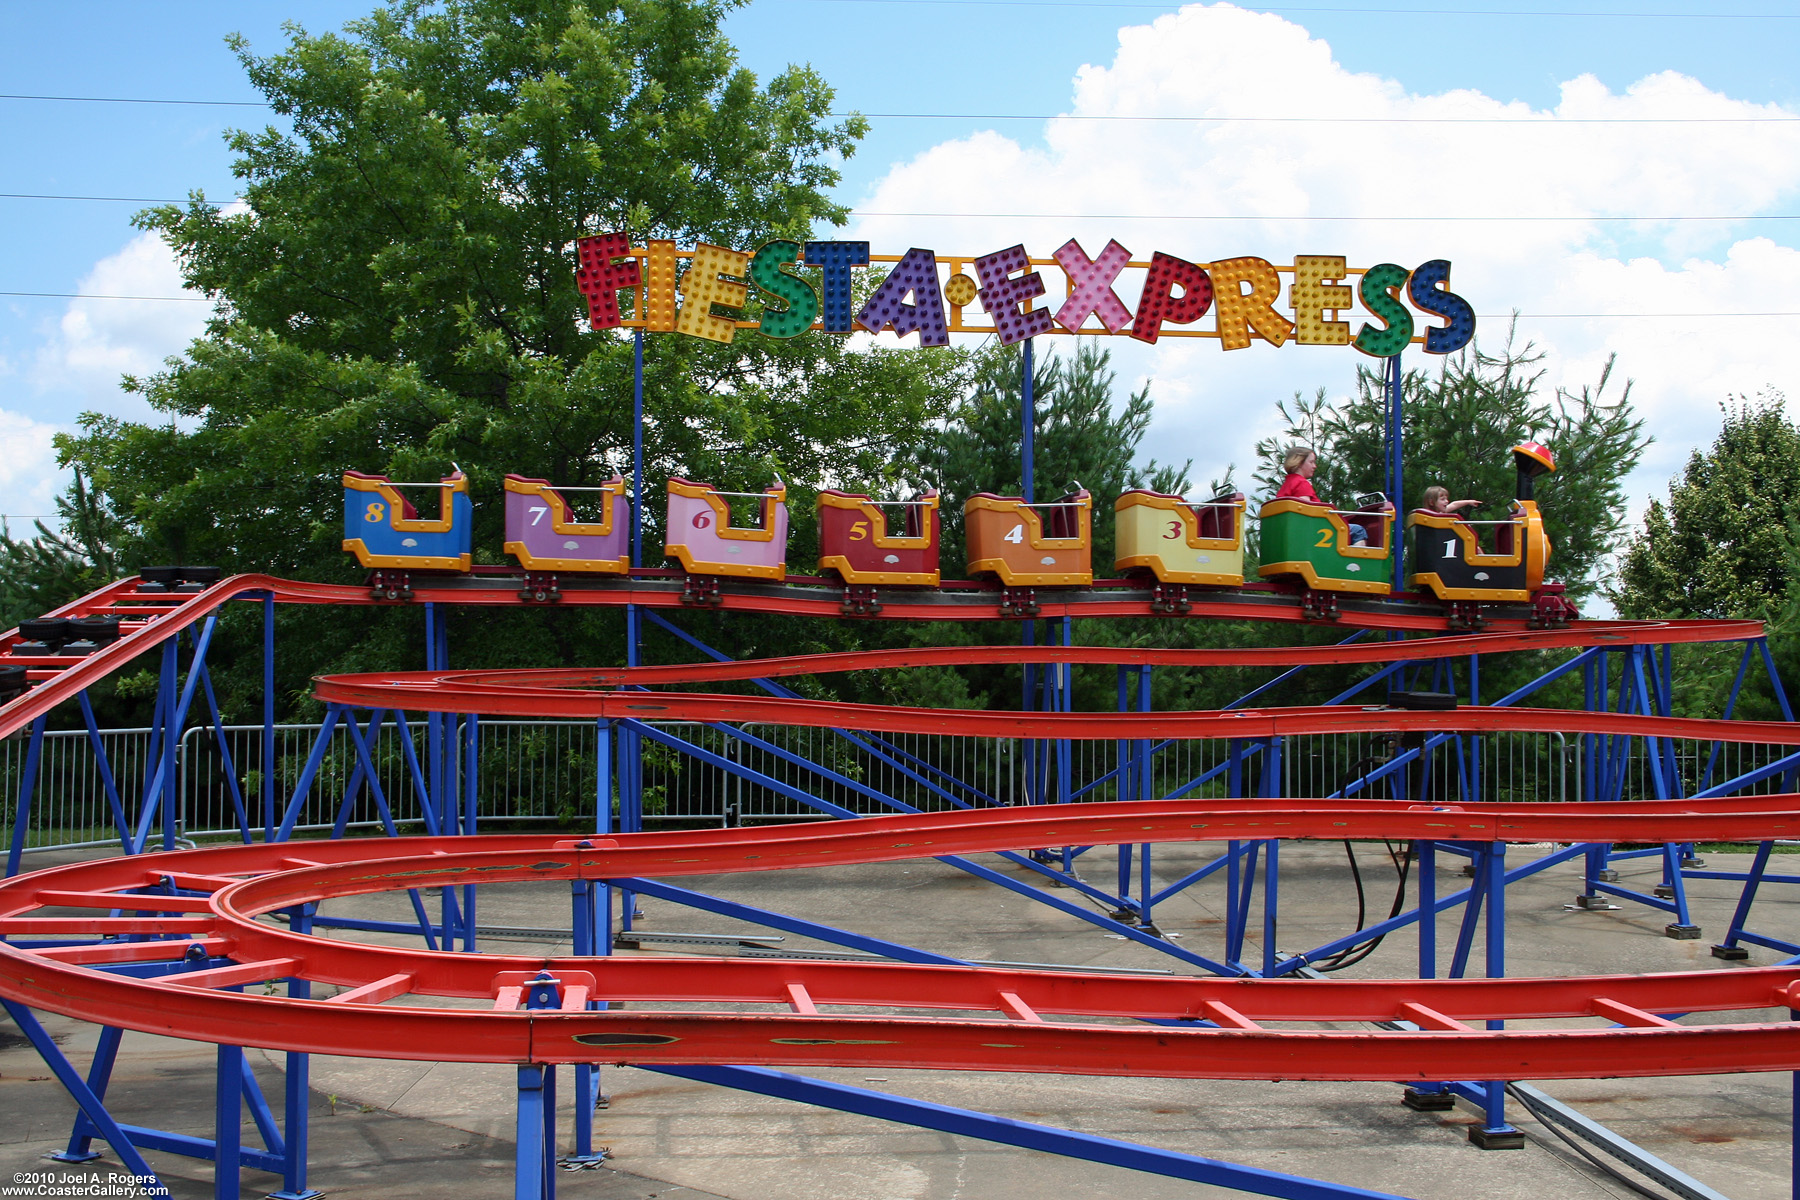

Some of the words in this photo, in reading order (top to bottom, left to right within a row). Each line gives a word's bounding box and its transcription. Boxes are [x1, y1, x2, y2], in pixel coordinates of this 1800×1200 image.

[577, 231, 949, 347] FIESTA
[973, 238, 1476, 358] EXPRESS
[364, 503, 385, 523] 8
[528, 507, 548, 526] 7
[692, 510, 713, 529] 6
[849, 521, 868, 541] 5
[1004, 524, 1023, 544] 4
[1162, 521, 1182, 540] 3
[1314, 529, 1333, 548] 2
[1442, 539, 1457, 559] 1
